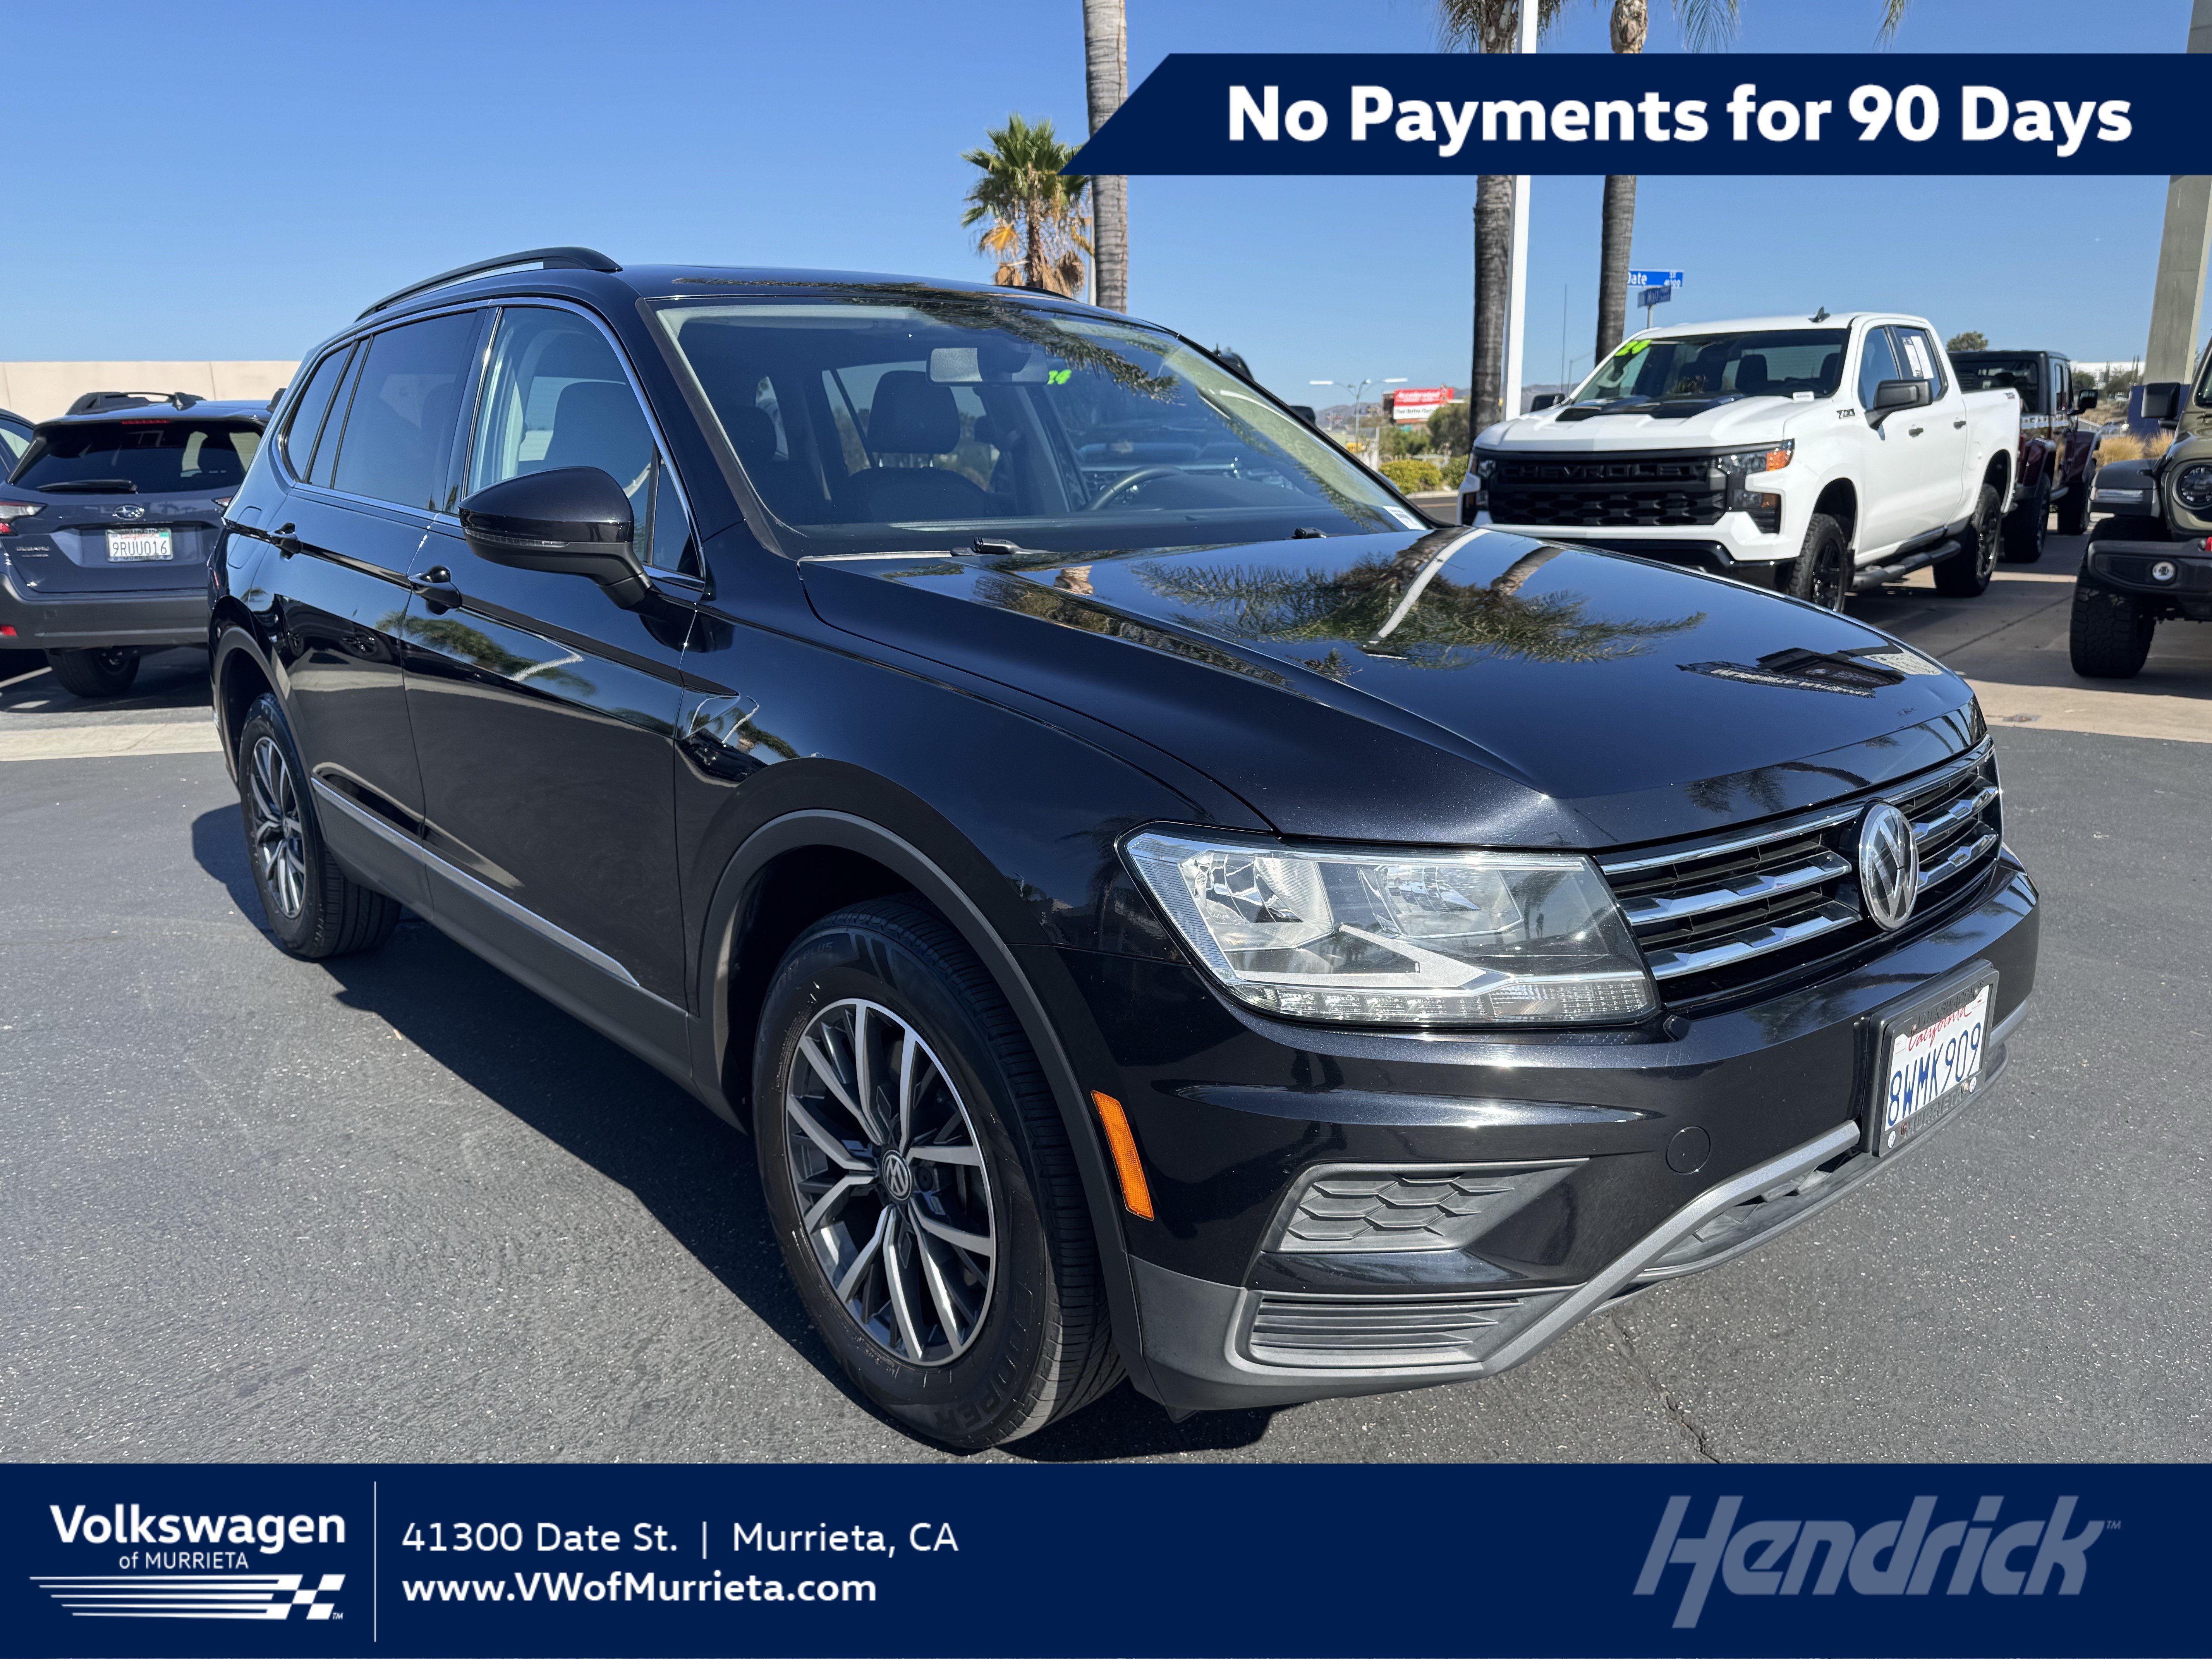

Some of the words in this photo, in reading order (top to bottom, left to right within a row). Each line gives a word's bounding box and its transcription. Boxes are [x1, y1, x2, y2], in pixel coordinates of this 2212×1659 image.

[1502, 463, 1708, 478] CHEVROLET
[112, 540, 167, 556] 9RUU016
[803, 941, 834, 961] PLUS
[1887, 1022, 1982, 1127] 8WMK909
[933, 1280, 1033, 1428] COOPER
